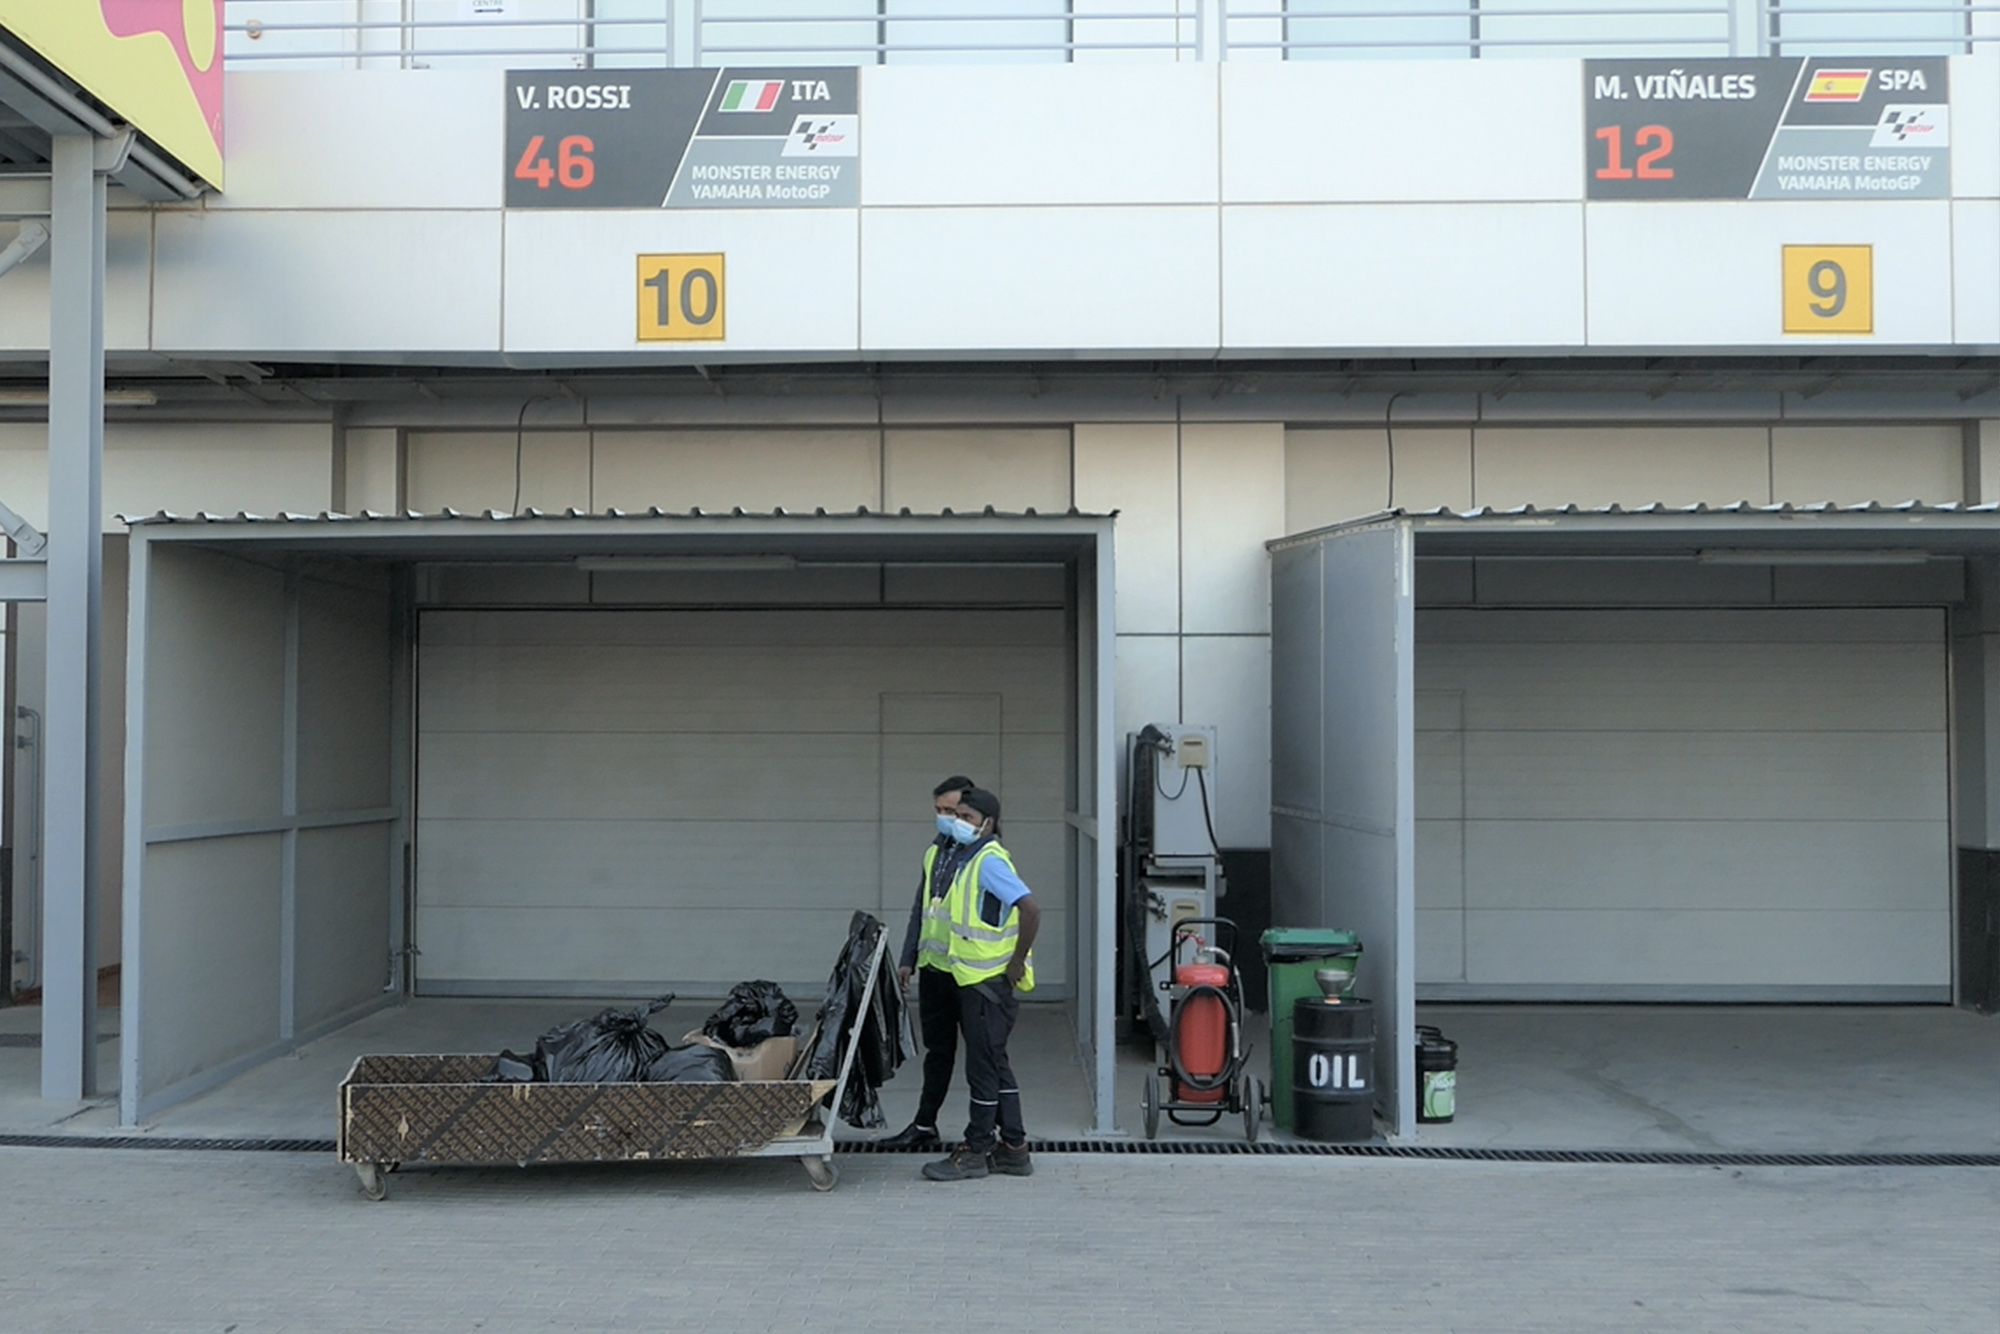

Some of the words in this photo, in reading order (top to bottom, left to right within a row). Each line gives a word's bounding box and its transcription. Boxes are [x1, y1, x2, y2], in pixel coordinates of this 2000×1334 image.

[791, 80, 831, 101] ITA
[1594, 75, 1628, 99] M.
[1634, 69, 1756, 99] VIÑALES
[1878, 70, 1926, 91] SPA
[516, 86, 540, 109] V.
[547, 86, 631, 109] ROSSI
[514, 135, 595, 189] 46
[1594, 125, 1675, 180] 12
[1778, 156, 1859, 171] MONSTER
[1863, 156, 1931, 171] ENERGY
[691, 165, 772, 181] MONSTER
[775, 165, 841, 180] ENERGY
[1778, 175, 1851, 191] YAMAHA
[1854, 175, 1921, 190] MotoGP
[691, 185, 762, 199] YAMAHA
[766, 184, 830, 199] MotoGP
[643, 268, 717, 326] 10
[1806, 259, 1848, 318] 9
[1309, 1054, 1365, 1088] OIL
